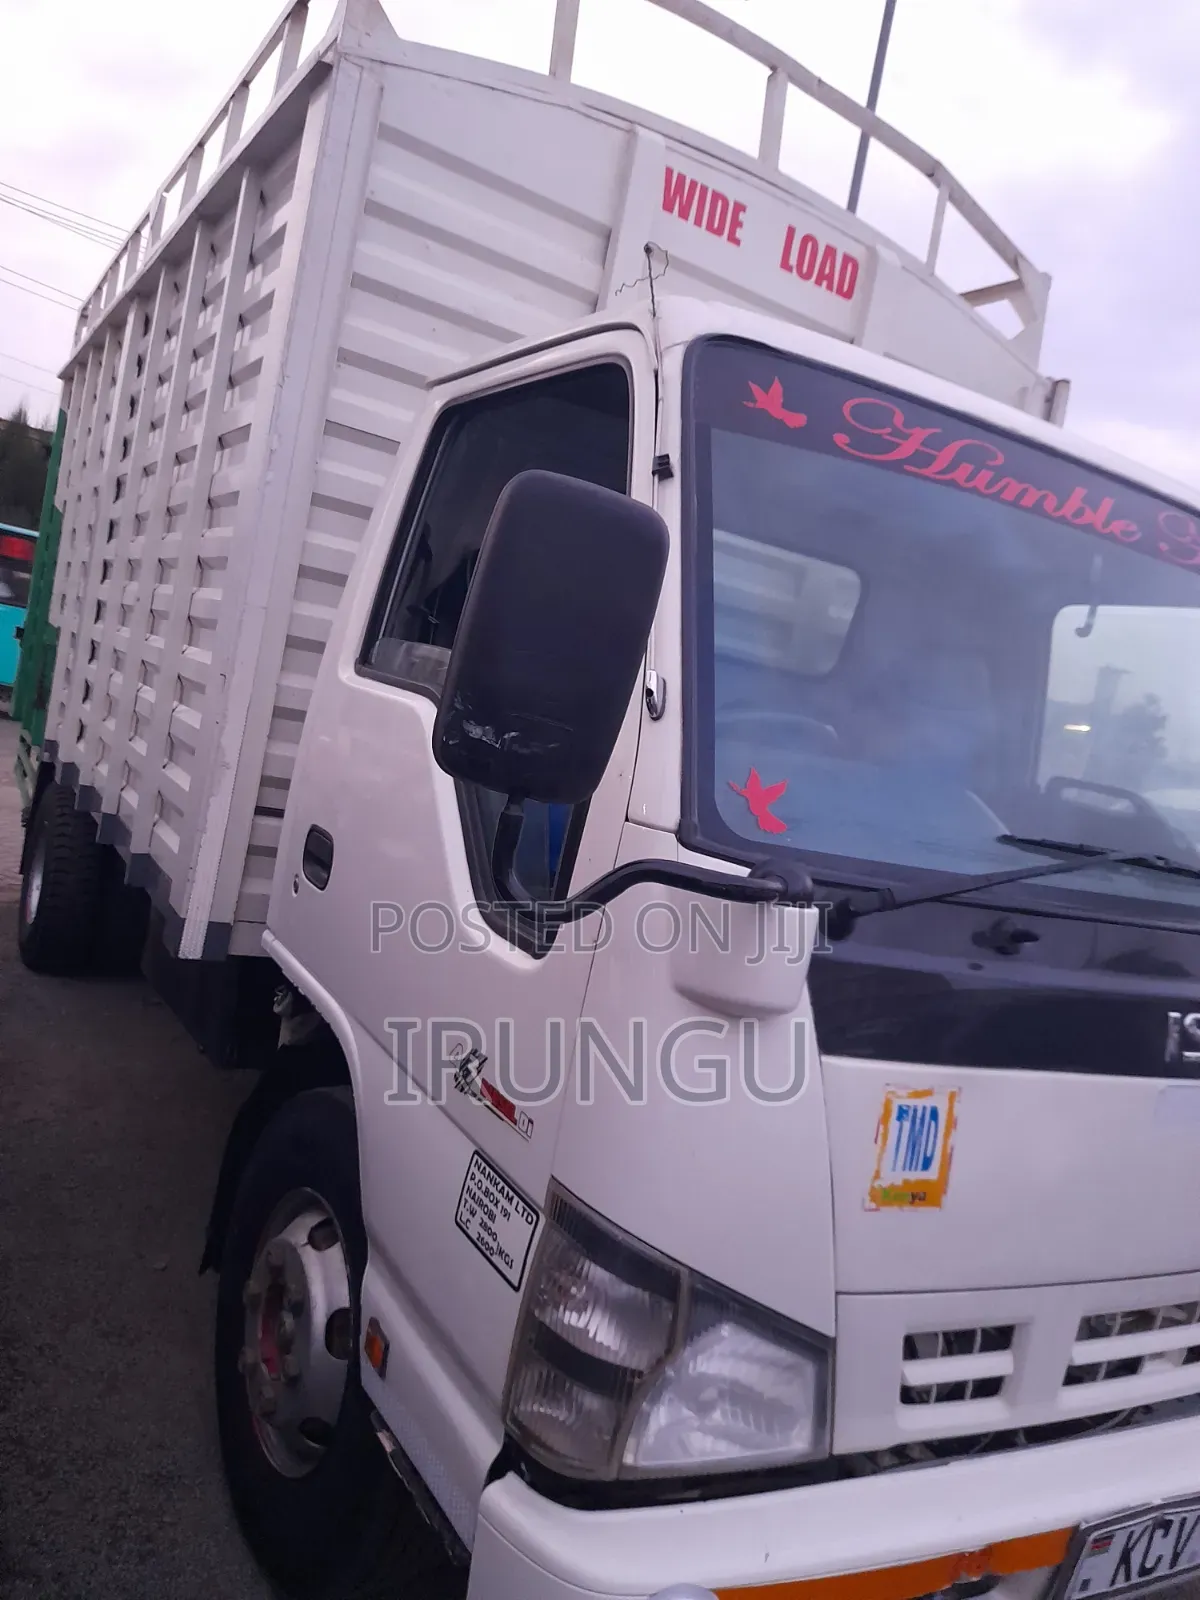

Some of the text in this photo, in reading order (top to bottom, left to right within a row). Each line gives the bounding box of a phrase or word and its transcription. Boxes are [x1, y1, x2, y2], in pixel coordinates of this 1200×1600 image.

[662, 166, 860, 301] WIDE LOAD
[833, 397, 1141, 543] Humble
[466, 1185, 497, 1224] NAIROBI
[474, 1158, 513, 1205] NANKAM
[515, 1204, 534, 1226] LTD
[500, 1204, 511, 1222] 191
[1109, 1514, 1200, 1588] KCV
